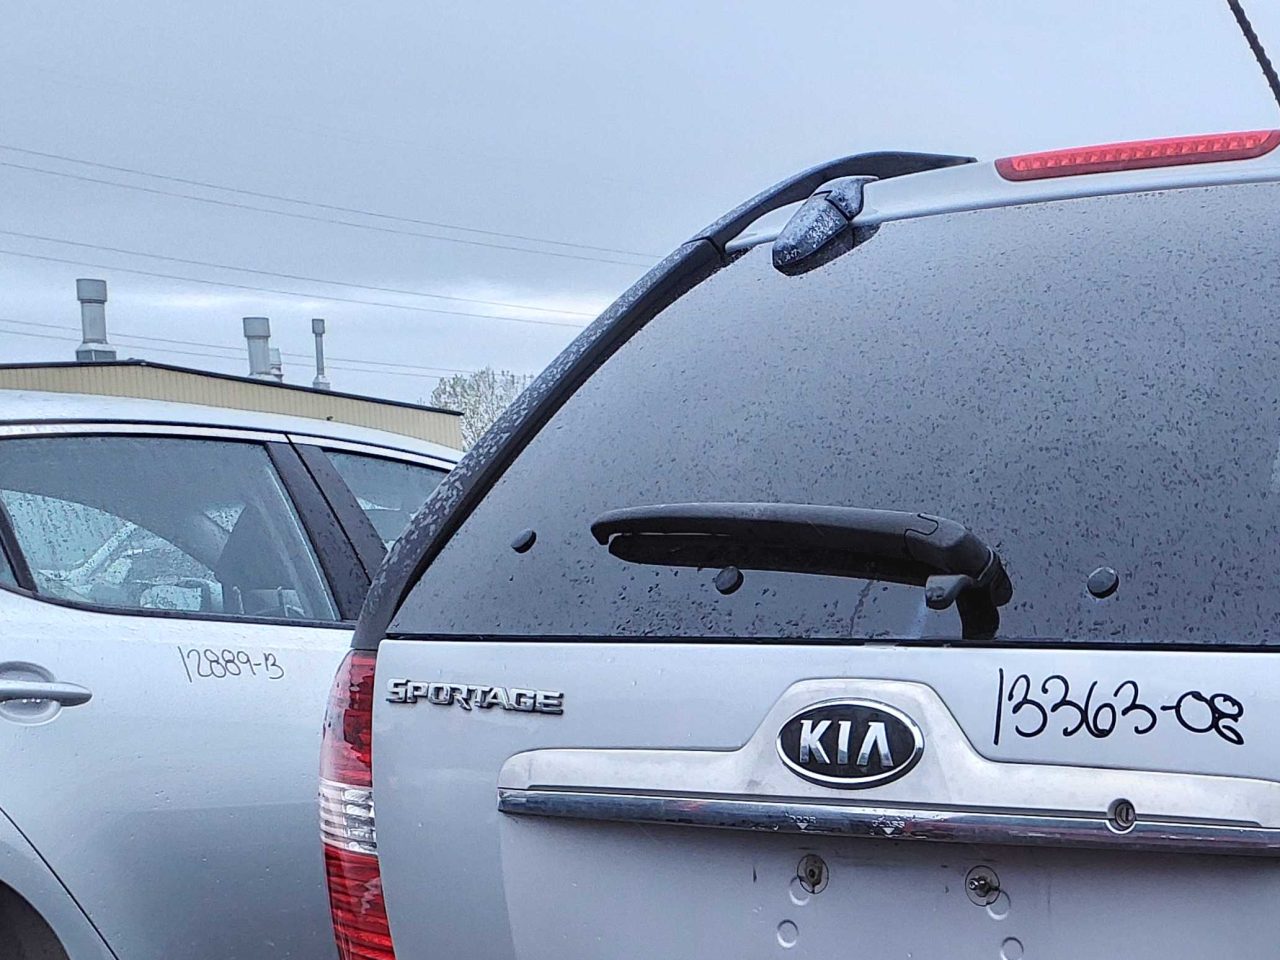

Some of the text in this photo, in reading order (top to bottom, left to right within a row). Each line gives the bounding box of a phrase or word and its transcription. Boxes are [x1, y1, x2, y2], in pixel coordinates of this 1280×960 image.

[386, 677, 565, 715] SPORTAGE
[993, 667, 1245, 746] 13363-08
[799, 719, 895, 767] KIA
